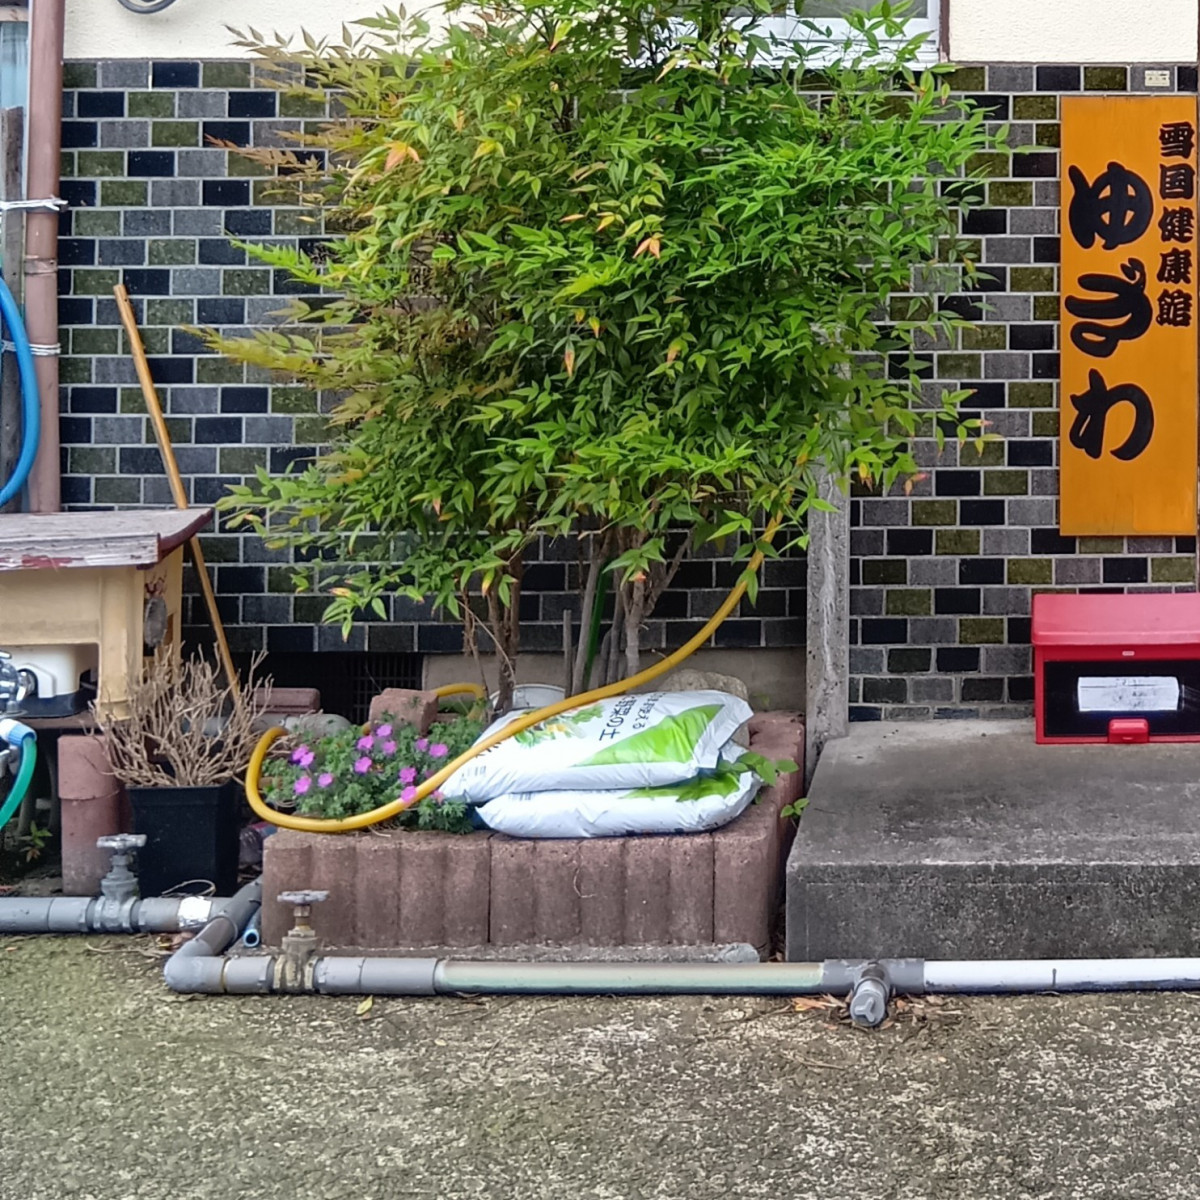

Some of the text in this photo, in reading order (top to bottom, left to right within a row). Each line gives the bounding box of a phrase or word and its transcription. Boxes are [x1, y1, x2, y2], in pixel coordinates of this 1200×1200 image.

[1064, 161, 1155, 461] ゆざわ
[1156, 121, 1195, 327] 雪国健康館
